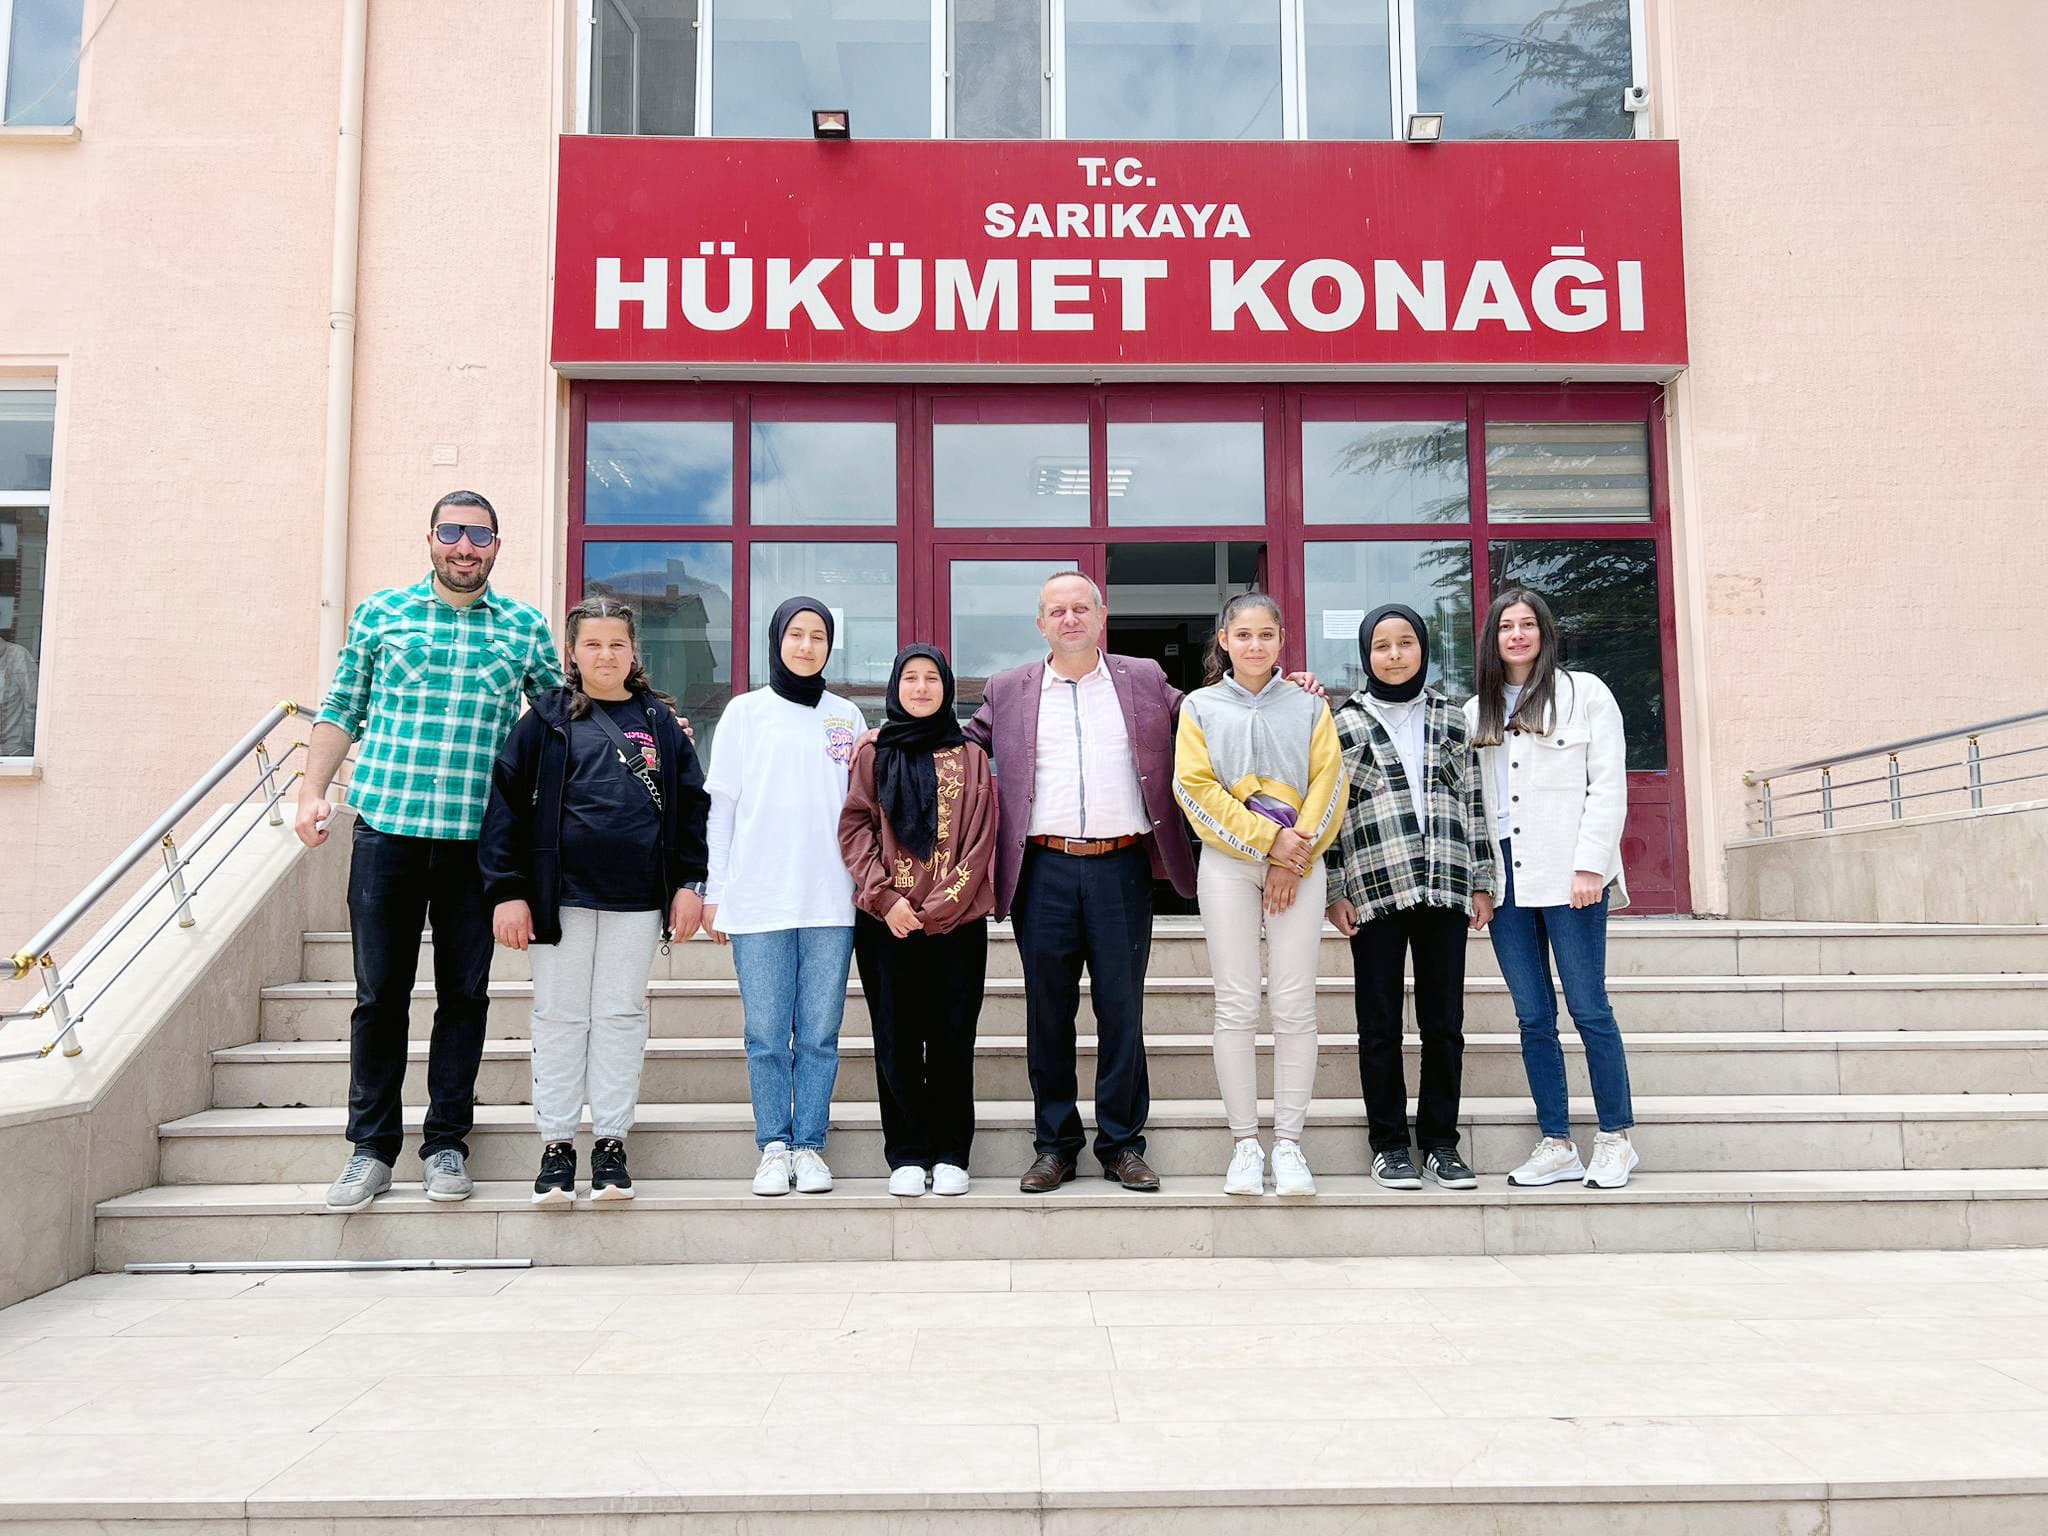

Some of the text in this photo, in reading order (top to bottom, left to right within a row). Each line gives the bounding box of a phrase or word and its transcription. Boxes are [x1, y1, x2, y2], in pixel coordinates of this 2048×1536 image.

[1077, 157, 1157, 187] T.C.
[984, 202, 1251, 239] SARIKAYA
[594, 241, 1645, 333] HÜKÜMET KONAĞI
